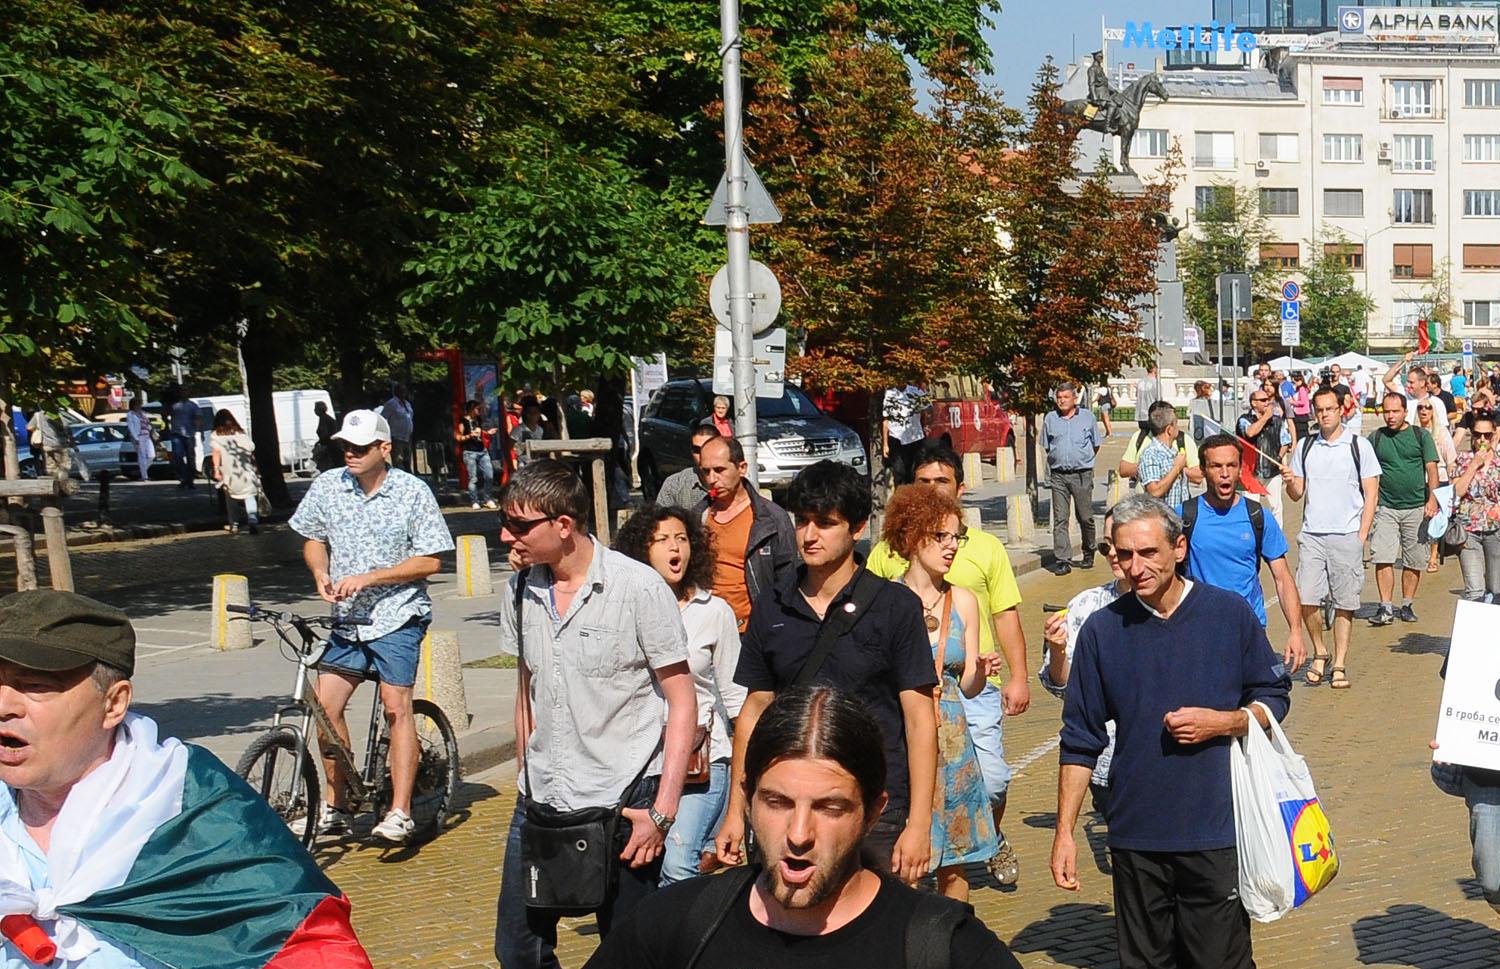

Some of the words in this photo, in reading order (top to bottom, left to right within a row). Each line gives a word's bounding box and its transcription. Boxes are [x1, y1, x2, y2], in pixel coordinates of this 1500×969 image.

[1370, 14, 1433, 30] ALPHA
[1438, 14, 1495, 31] BANK
[1123, 19, 1257, 52] MetLife
[1446, 707, 1453, 717] В
[1456, 711, 1485, 722] гроба
[1488, 715, 1500, 724] се
